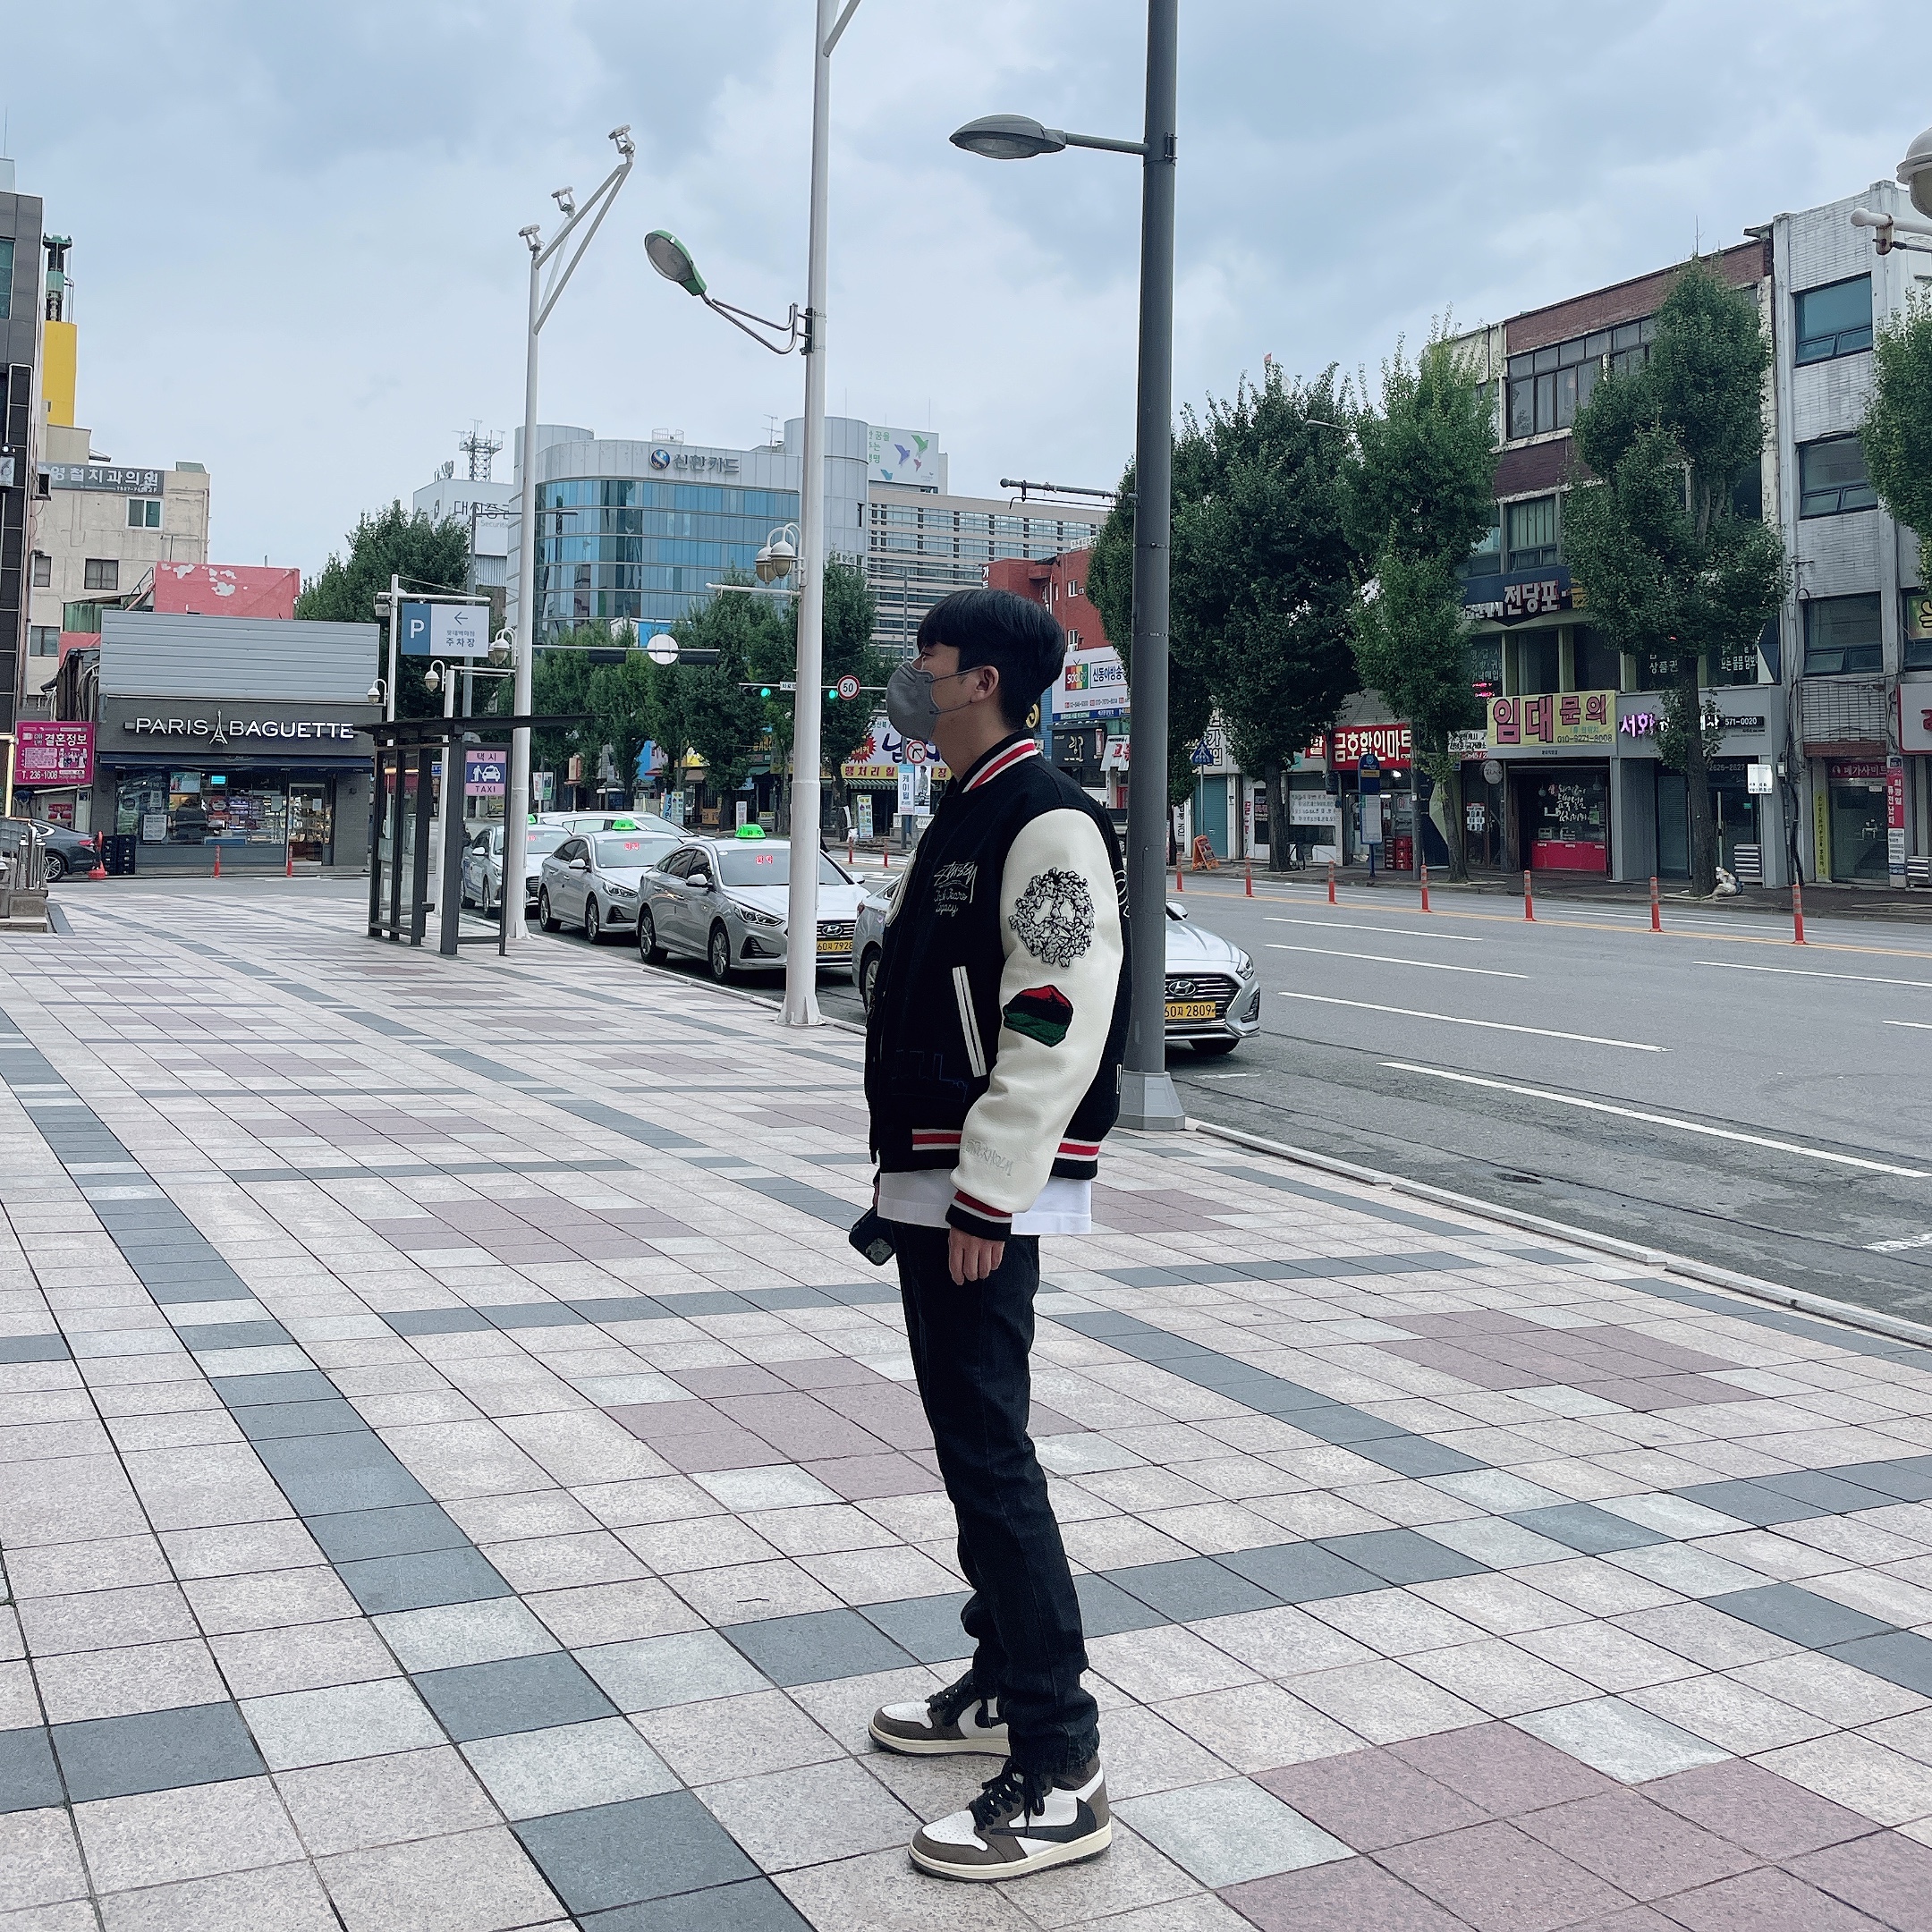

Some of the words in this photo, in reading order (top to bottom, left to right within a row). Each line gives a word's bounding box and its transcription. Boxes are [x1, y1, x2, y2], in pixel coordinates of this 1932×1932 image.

[673, 453, 740, 473] 신한카드
[1504, 580, 1560, 615] 전당포
[410, 618, 425, 639] P
[446, 637, 476, 648] 주차장
[1092, 665, 1123, 682] 신동아방송
[843, 682, 854, 693] 50
[1492, 694, 1555, 745] 임대
[1559, 693, 1607, 726] 문의
[135, 716, 208, 735] PARIS
[229, 719, 355, 739] BAGUETTE
[45, 733, 88, 747] 결혼정보
[1334, 728, 1411, 763] 금호할인마트
[476, 752, 497, 761] 택시
[844, 766, 880, 777] 땡처리
[475, 785, 496, 793] TAXI
[1185, 1004, 1212, 1017] 2809
